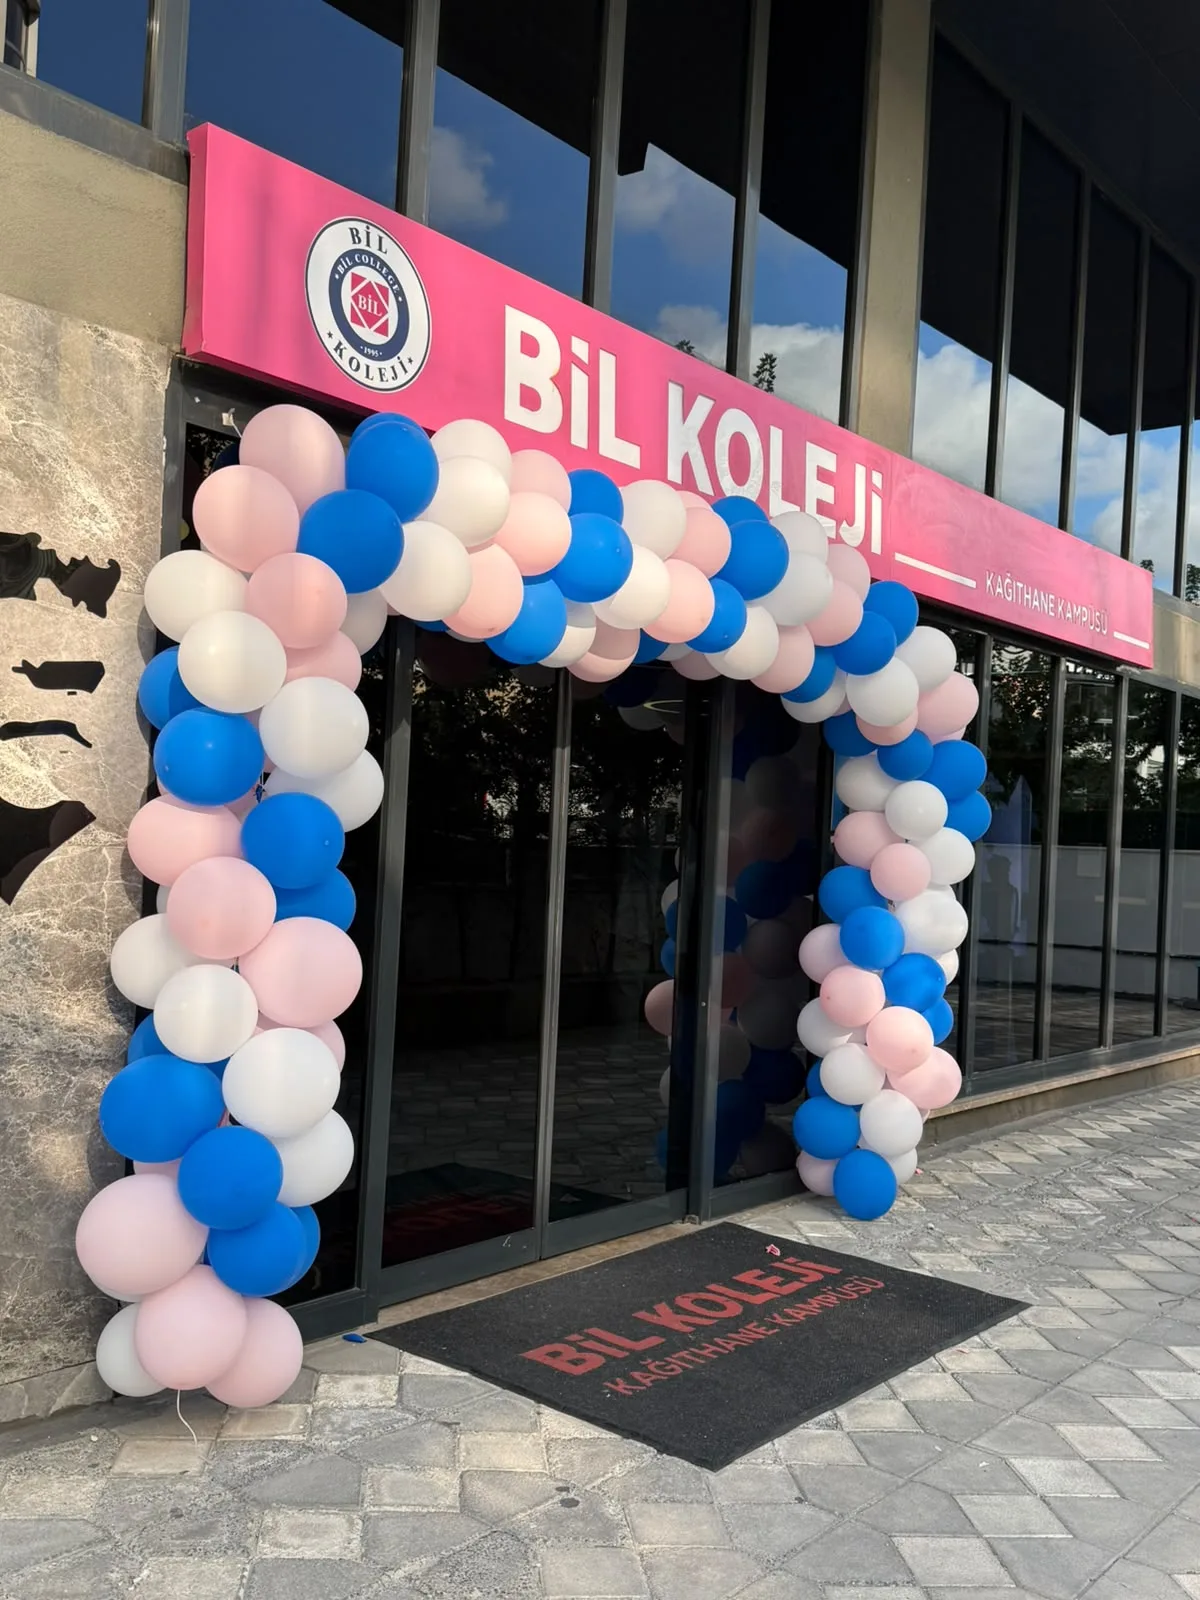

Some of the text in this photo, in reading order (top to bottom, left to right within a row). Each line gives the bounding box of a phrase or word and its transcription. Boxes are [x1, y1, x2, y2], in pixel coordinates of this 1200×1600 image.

[354, 253, 400, 293] COLLEGE
[363, 346, 379, 358] 1995
[985, 571, 1108, 635] KAĞITHANE KAMPÜSÜ
[603, 1275, 885, 1395] KAĞITHANE KAMPÜSÜ
